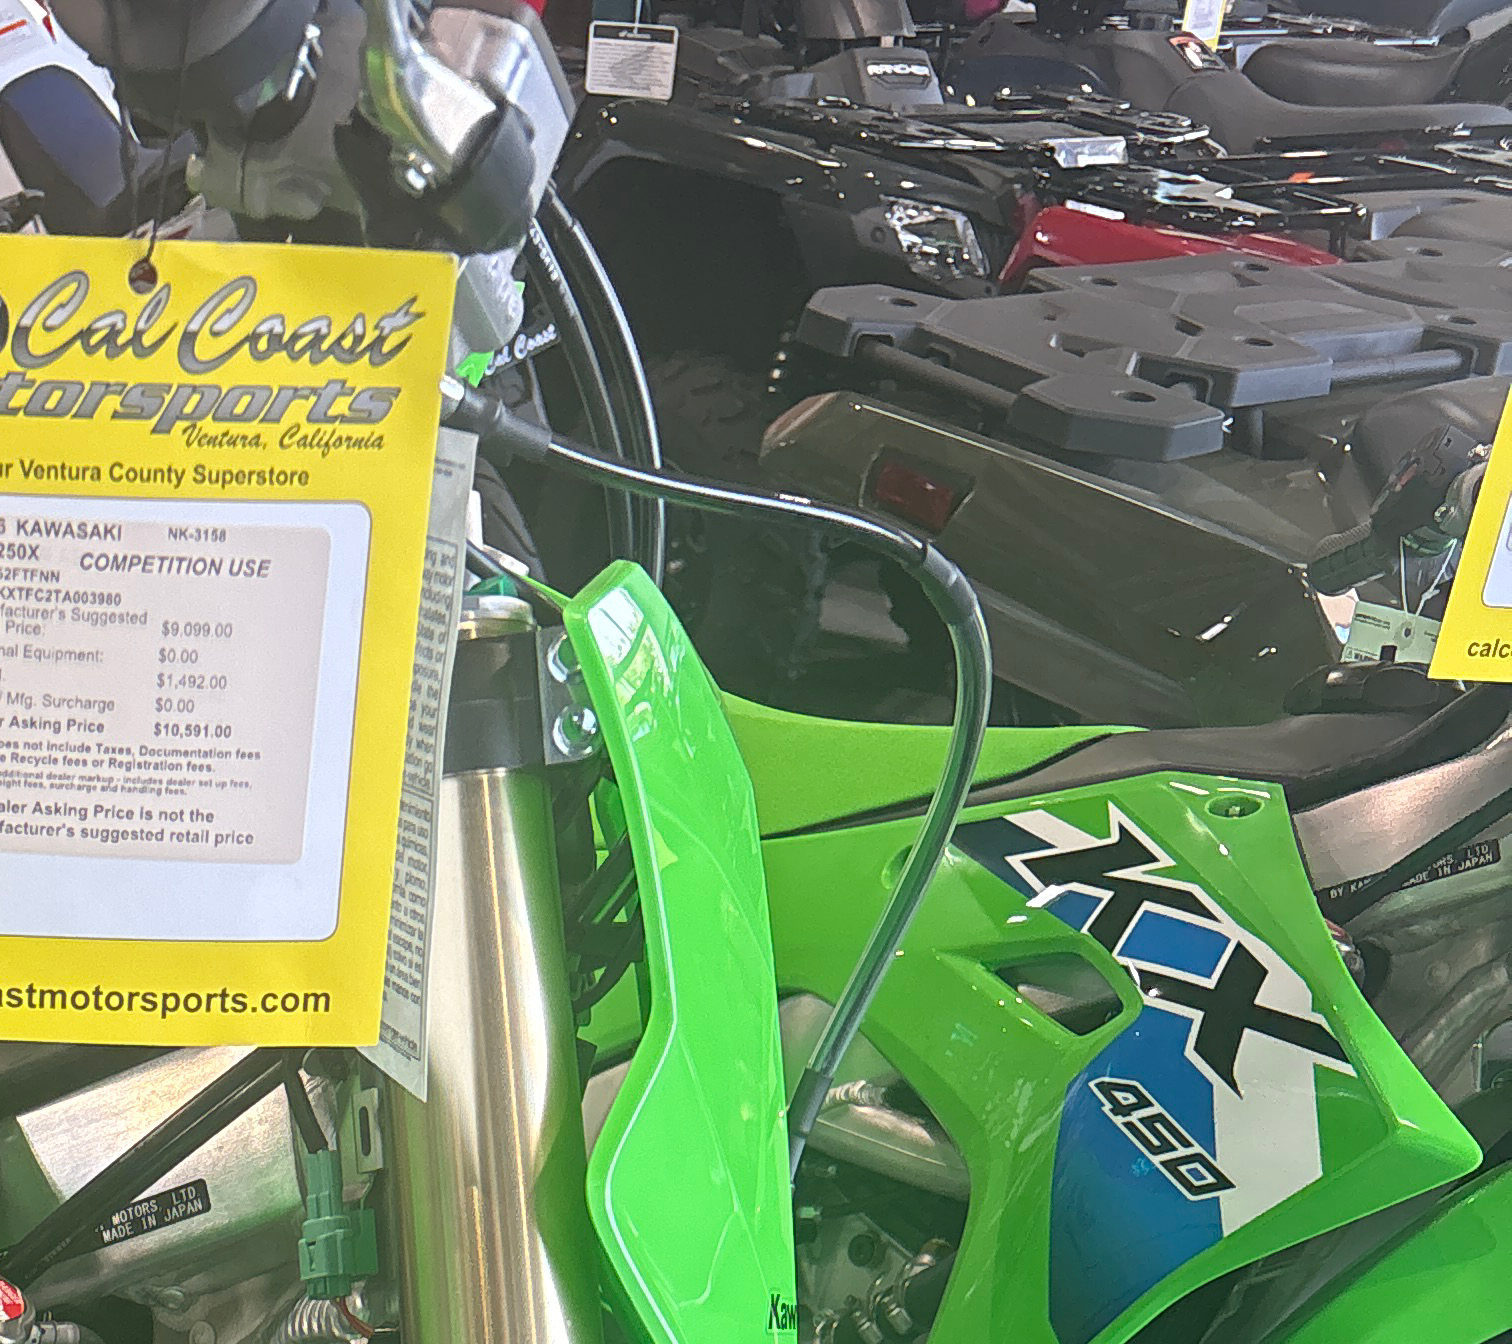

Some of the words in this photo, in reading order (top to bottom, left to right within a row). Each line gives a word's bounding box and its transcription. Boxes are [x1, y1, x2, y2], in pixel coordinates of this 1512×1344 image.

[11, 270, 178, 370] Cal
[178, 276, 426, 374] Coast
[182, 423, 267, 450] Ventura,
[279, 426, 385, 457] California
[20, 459, 101, 482] Ventura
[109, 462, 186, 489] County
[192, 464, 310, 489] Superstore
[16, 519, 122, 542] KAWASAKI
[168, 527, 227, 543] NK-3158
[80, 553, 224, 578] COMPETITION
[228, 558, 271, 578] USE
[71, 608, 148, 627] Suggested
[23, 644, 103, 663] Equipment:
[158, 648, 198, 664] $0.00
[156, 672, 228, 690] $1,492.00
[42, 693, 115, 714] Surcharge
[155, 698, 195, 713] $0.00
[9, 715, 61, 734] Asking
[67, 718, 105, 734] Price
[153, 722, 232, 739] $10,591.00
[23, 741, 43, 751] not
[47, 740, 92, 754] include
[139, 745, 232, 760] Documentation
[235, 748, 261, 761] fees
[10, 752, 58, 768] Recycle
[62, 755, 88, 767] fees
[91, 758, 105, 768] or
[108, 757, 183, 773] Registration
[32, 801, 88, 821] Asking
[93, 804, 134, 820] Price
[139, 806, 153, 821] is
[158, 809, 185, 823] not
[190, 808, 215, 823] the
[80, 827, 165, 844] suggested
[169, 829, 209, 844] retail
[214, 830, 254, 847] price
[1021, 822, 1350, 1099] KX
[1091, 1078, 1237, 1199] 450
[102, 1223, 134, 1244] MADE
[142, 1214, 157, 1230] IN
[164, 1199, 203, 1223] JAPAN
